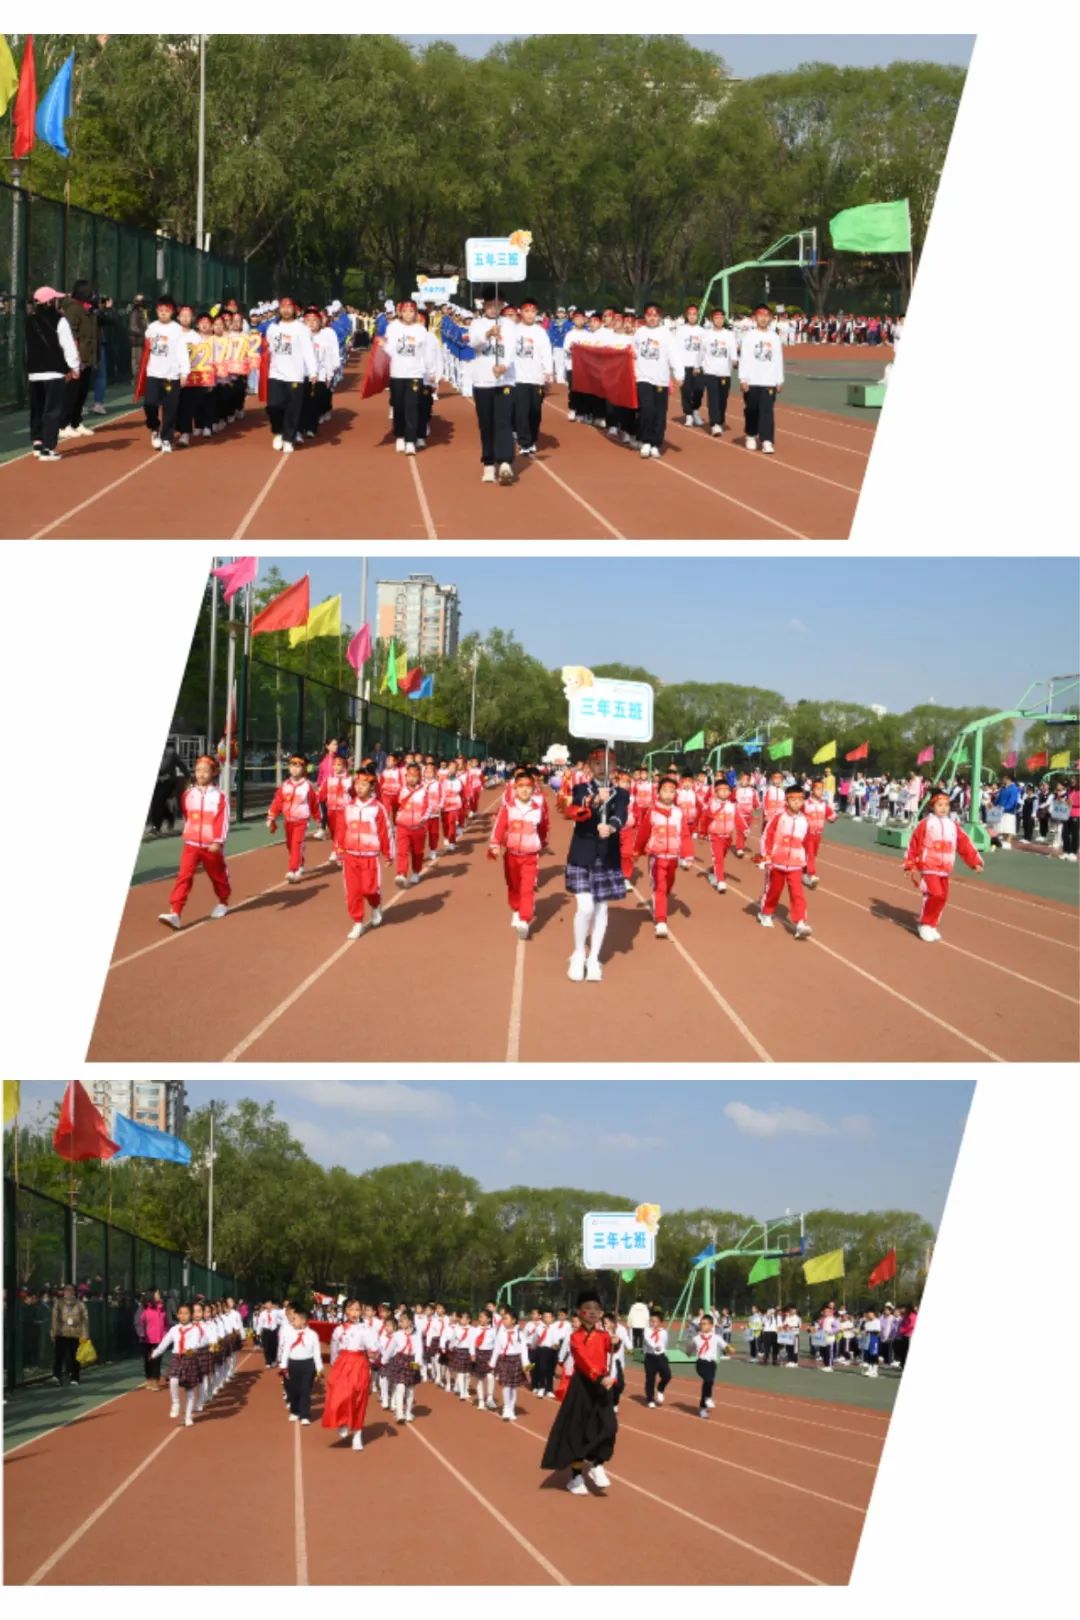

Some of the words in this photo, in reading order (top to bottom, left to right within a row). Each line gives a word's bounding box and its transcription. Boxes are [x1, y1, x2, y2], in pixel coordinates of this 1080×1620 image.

[473, 252, 519, 266] 五年三班
[581, 697, 643, 719] 三年五班
[593, 1231, 646, 1249] 三年七班
